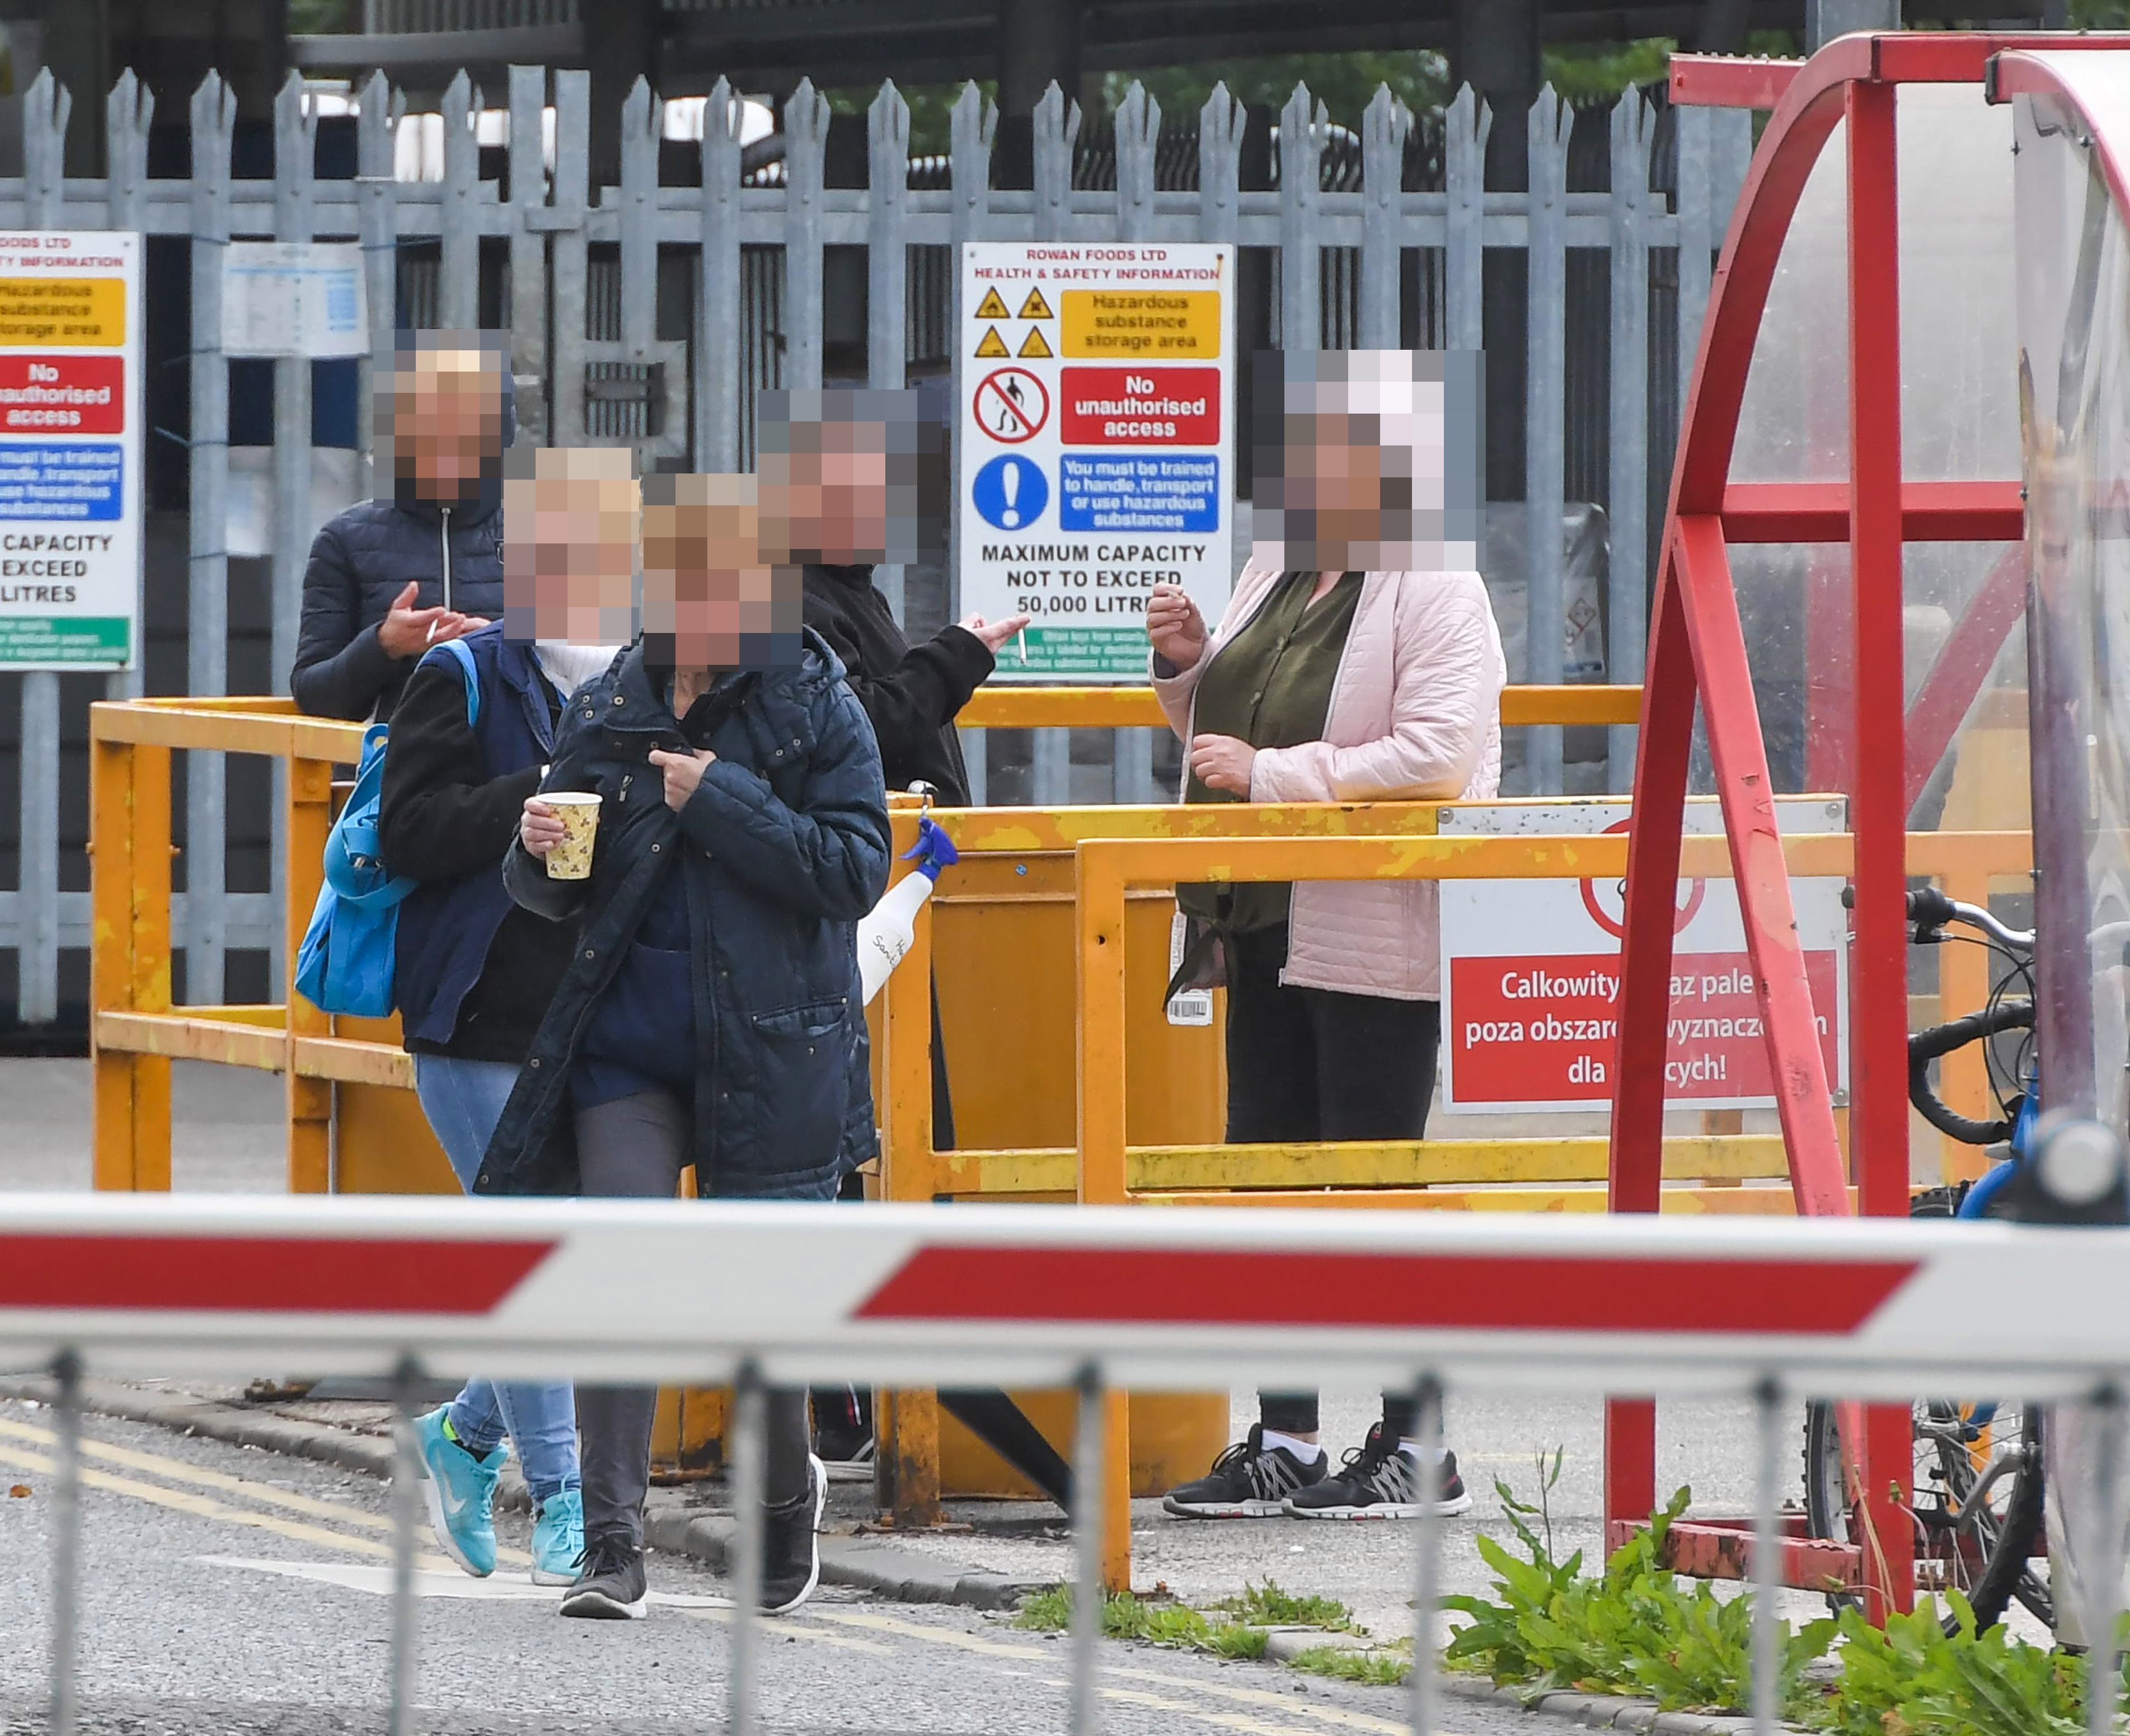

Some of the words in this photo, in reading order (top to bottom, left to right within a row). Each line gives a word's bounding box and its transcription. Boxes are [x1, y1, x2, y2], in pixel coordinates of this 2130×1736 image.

[45, 238, 71, 248] LTD
[21, 257, 123, 266] INFORMATION
[1027, 250, 1080, 261] ROWAN
[1086, 250, 1135, 261] FOODS
[1142, 250, 1167, 261] LTD
[975, 268, 1031, 279] HEALTH
[1038, 269, 1046, 279] &
[1053, 269, 1110, 279] SAFETY
[1116, 269, 1219, 279] INFORMATION
[1092, 295, 1189, 309] Hazardous
[1095, 313, 1187, 329] substance
[63, 325, 101, 335] area
[1085, 334, 1151, 349] storage
[1158, 336, 1197, 348] area
[29, 363, 59, 382] No
[1125, 376, 1154, 393] No
[0, 385, 111, 405] authorised
[1075, 398, 1205, 416] unauthorised
[7, 410, 81, 426] access
[1104, 421, 1176, 437] access
[42, 450, 62, 463] be
[65, 450, 121, 464] trained
[45, 469, 119, 484] transport
[1065, 461, 1092, 475] You
[1096, 461, 1134, 475] must
[1137, 461, 1158, 475] be
[1161, 461, 1215, 476] trained
[26, 484, 111, 498] hazardous
[1065, 478, 1080, 492] to
[1142, 480, 1213, 496] transport
[1071, 496, 1089, 510] or
[1091, 497, 1121, 509] use
[1123, 495, 1206, 510] hazardous
[1094, 513, 1184, 527] substances
[4, 534, 112, 551] CAPACITY
[982, 545, 1088, 561] MAXIMUM
[1097, 545, 1206, 561] CAPACITY
[2, 560, 87, 576] EXCEED
[1007, 571, 1050, 587] NOT
[1059, 571, 1087, 587] TO
[1096, 571, 1181, 587] EXCEED
[1, 587, 76, 602] LITRES
[1017, 595, 1087, 615] 50,000
[1095, 596, 1151, 612] LITR
[1502, 970, 1621, 1003] Calkowity
[1702, 967, 1754, 1002] pale
[1466, 1021, 1524, 1049] poza
[1531, 1013, 1617, 1041] obszar
[1568, 1055, 1605, 1083] dla
[1664, 1054, 1726, 1088] cych!
